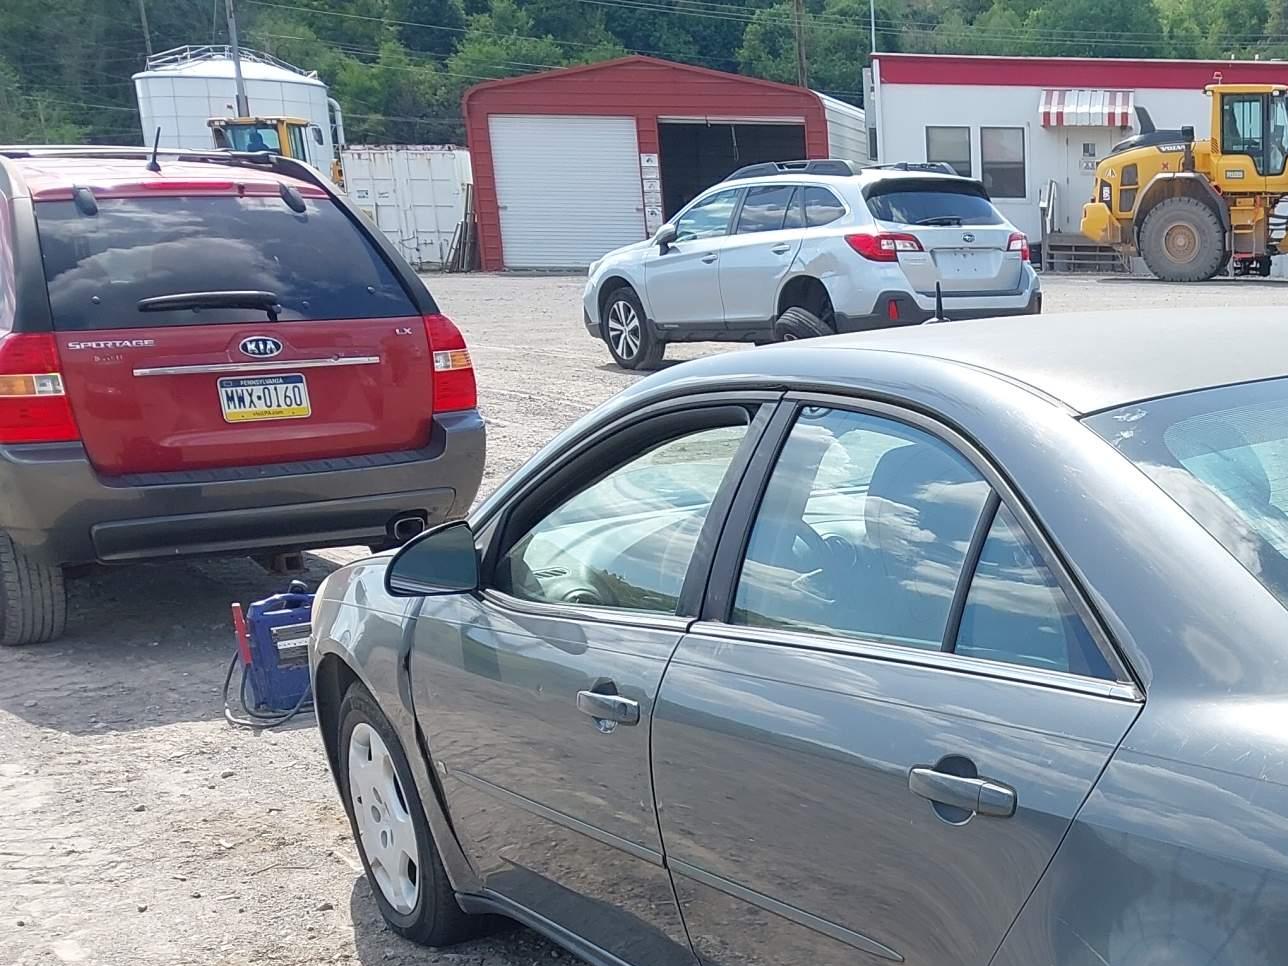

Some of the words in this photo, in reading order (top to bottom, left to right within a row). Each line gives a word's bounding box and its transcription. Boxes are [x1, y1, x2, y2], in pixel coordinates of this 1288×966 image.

[395, 327, 413, 335] LX
[68, 339, 154, 350] SPORTAGE
[245, 340, 277, 354] KIA
[240, 377, 284, 386] PENNSYLVANIA
